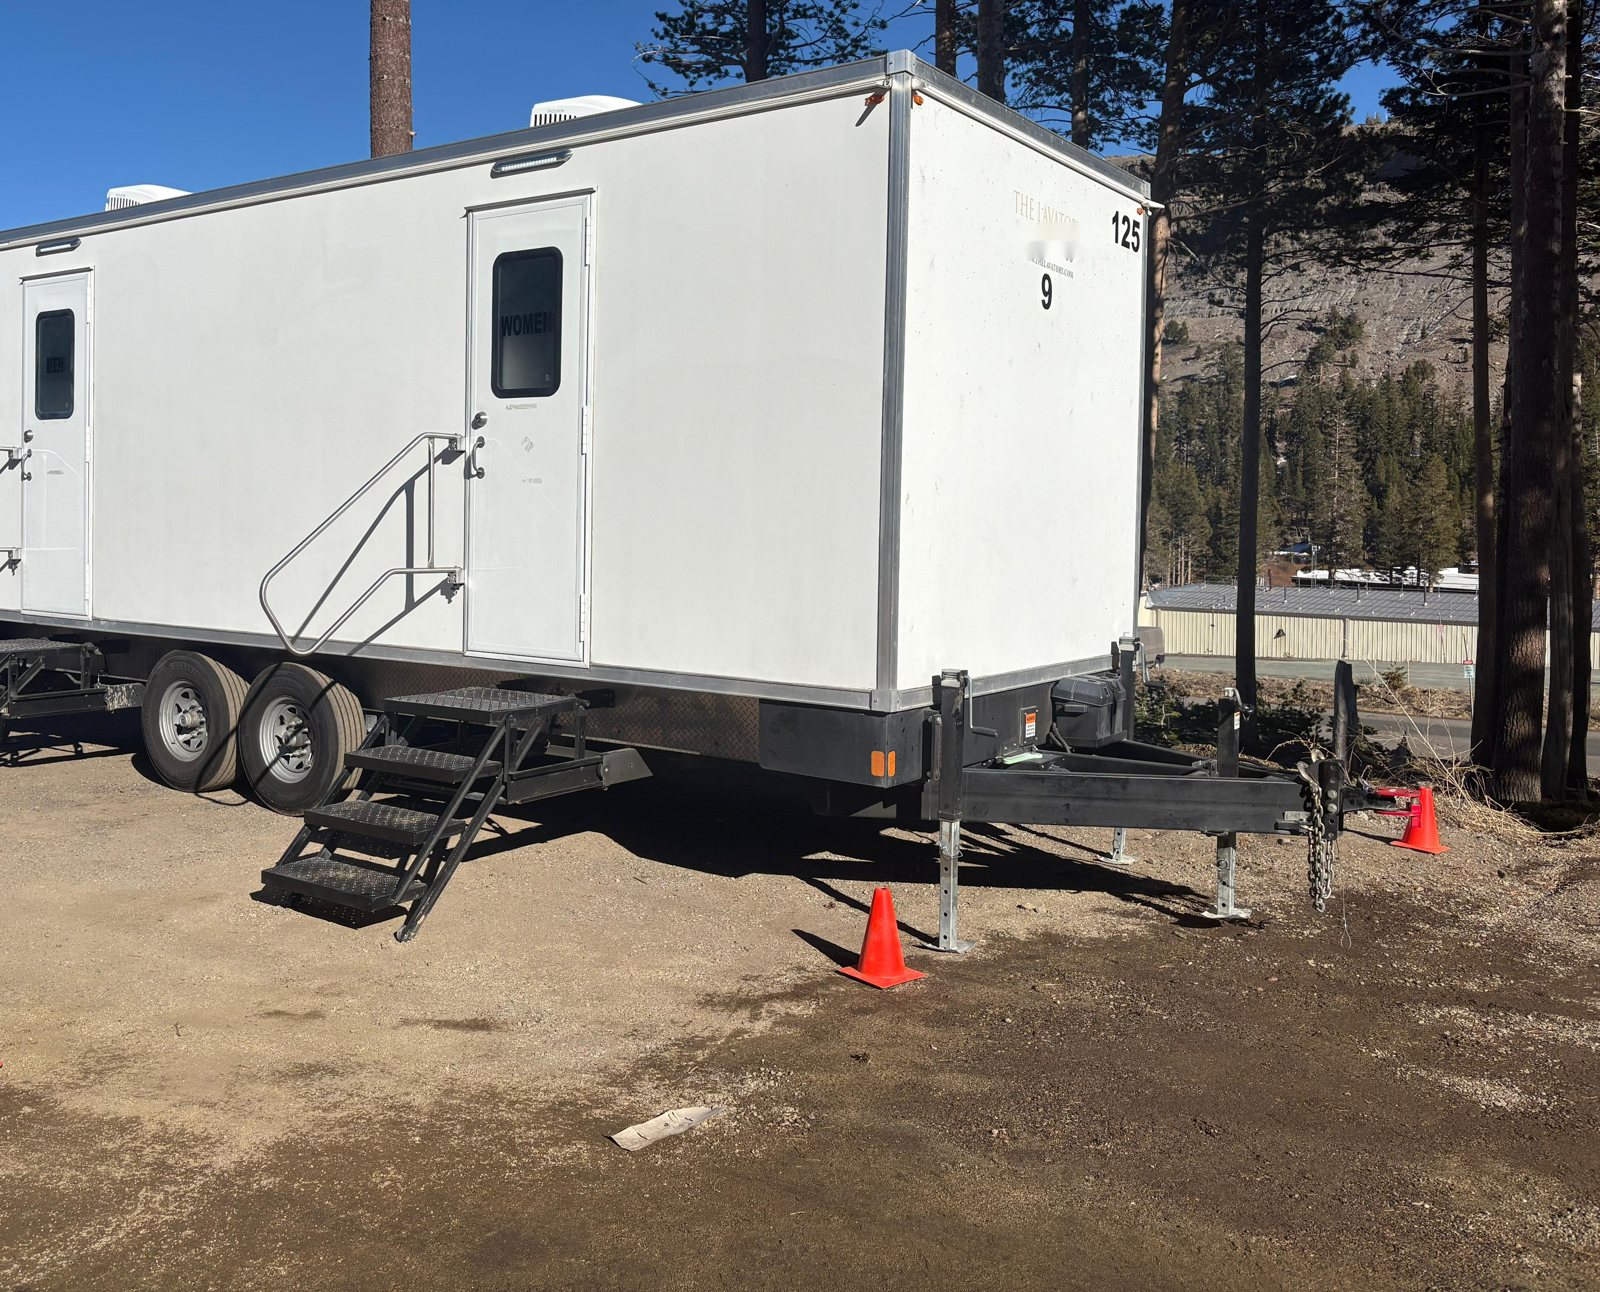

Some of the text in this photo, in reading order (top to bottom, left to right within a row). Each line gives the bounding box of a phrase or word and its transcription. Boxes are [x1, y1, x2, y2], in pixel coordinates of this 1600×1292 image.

[1014, 190, 1034, 221] THE
[1111, 211, 1140, 252] 125
[1041, 273, 1053, 310] 9
[500, 311, 552, 337] WOMEN
[46, 357, 64, 374] MEN
